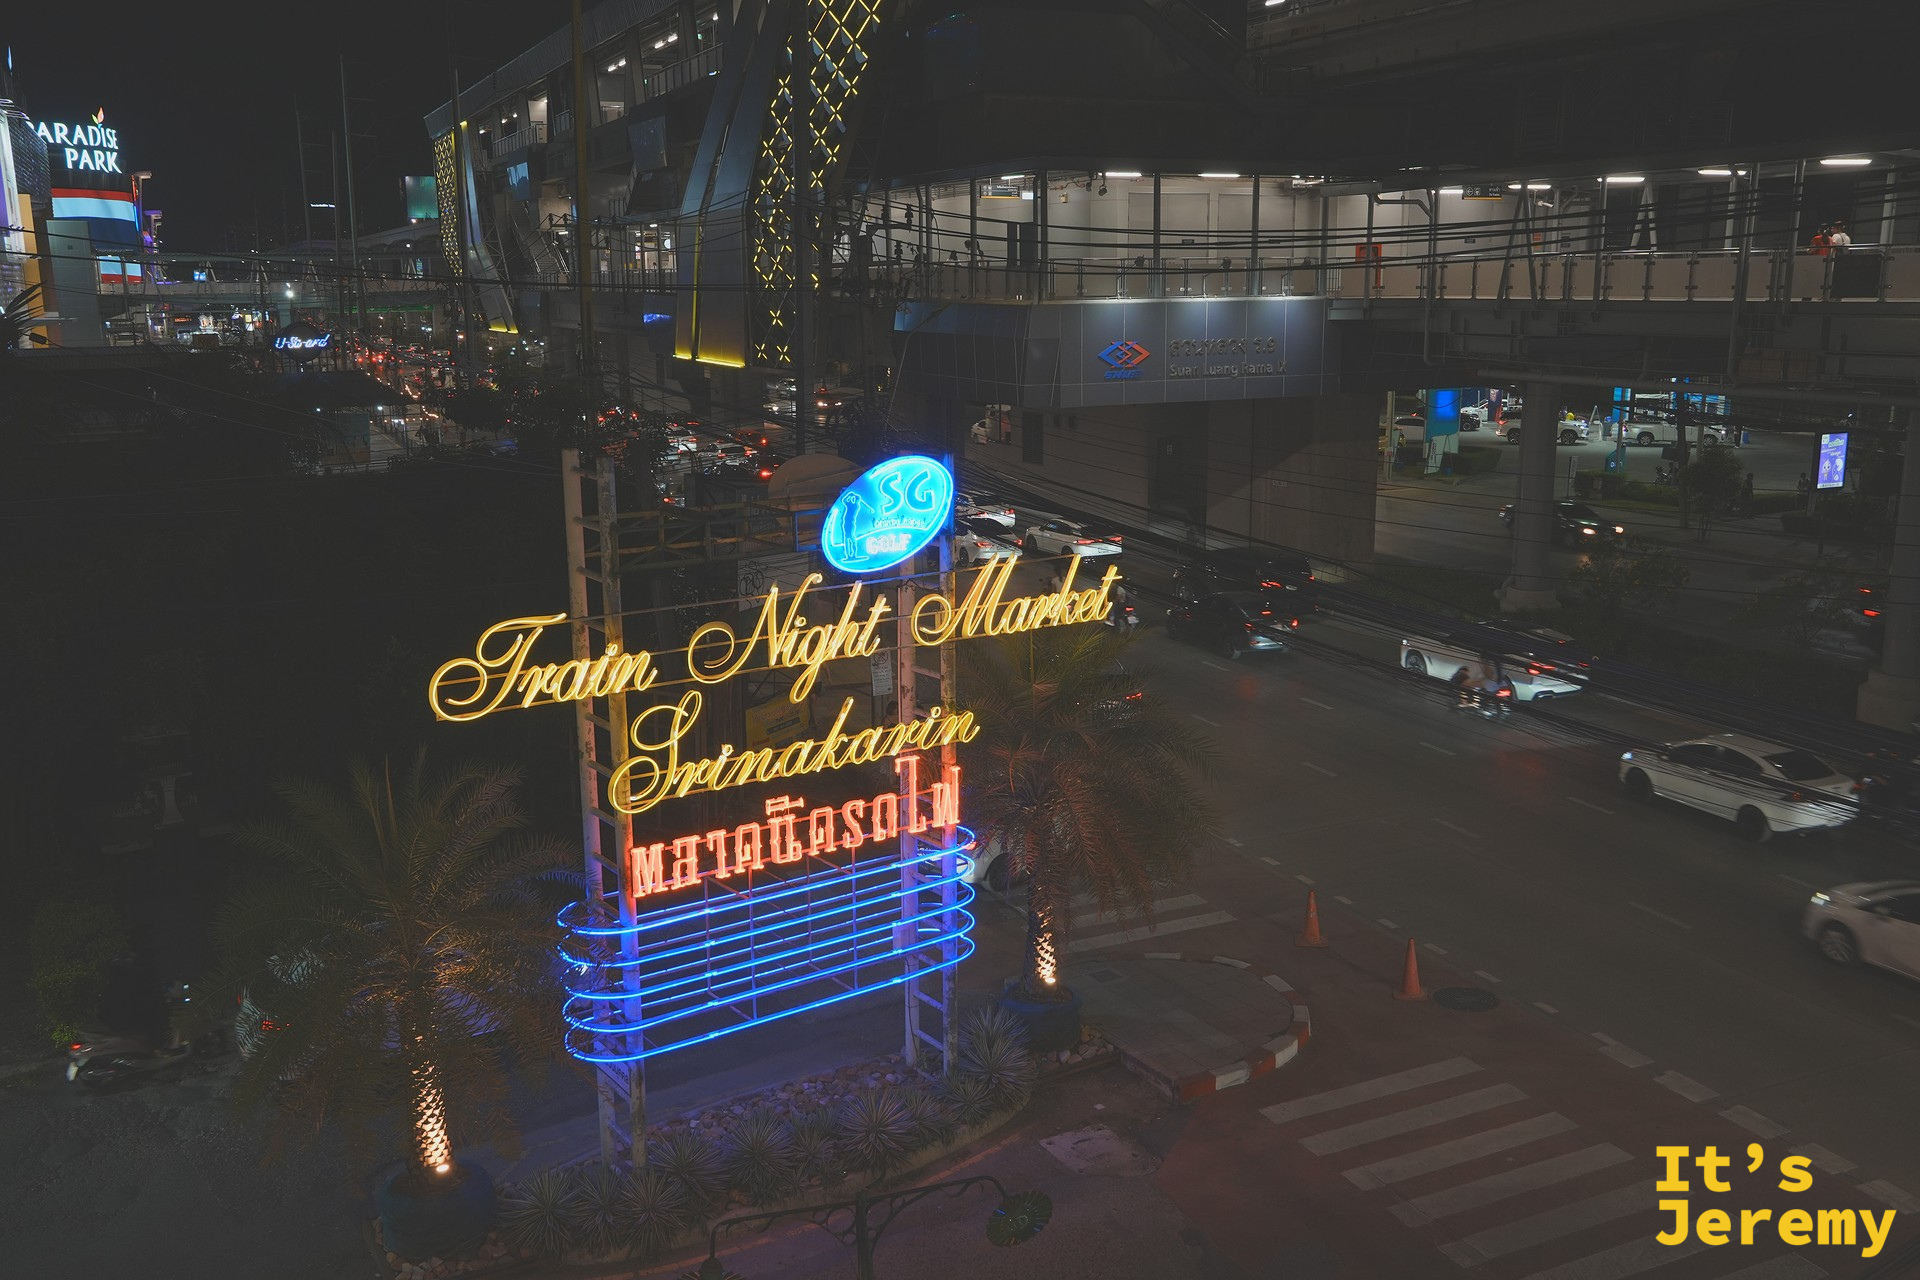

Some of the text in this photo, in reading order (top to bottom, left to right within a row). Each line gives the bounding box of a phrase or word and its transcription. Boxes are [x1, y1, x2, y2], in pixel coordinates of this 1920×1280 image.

[25, 121, 118, 149] ARADISE
[65, 147, 122, 174] PARK
[1169, 362, 1199, 377] Suan
[1203, 361, 1239, 377] Luang
[1241, 361, 1273, 375] Rama
[880, 469, 936, 516] SG
[866, 533, 912, 555] GOLF
[429, 552, 1123, 722] Train Night Market
[608, 688, 981, 814] Srinakarin
[631, 755, 961, 898] ตลาดนัดรถไฟ
